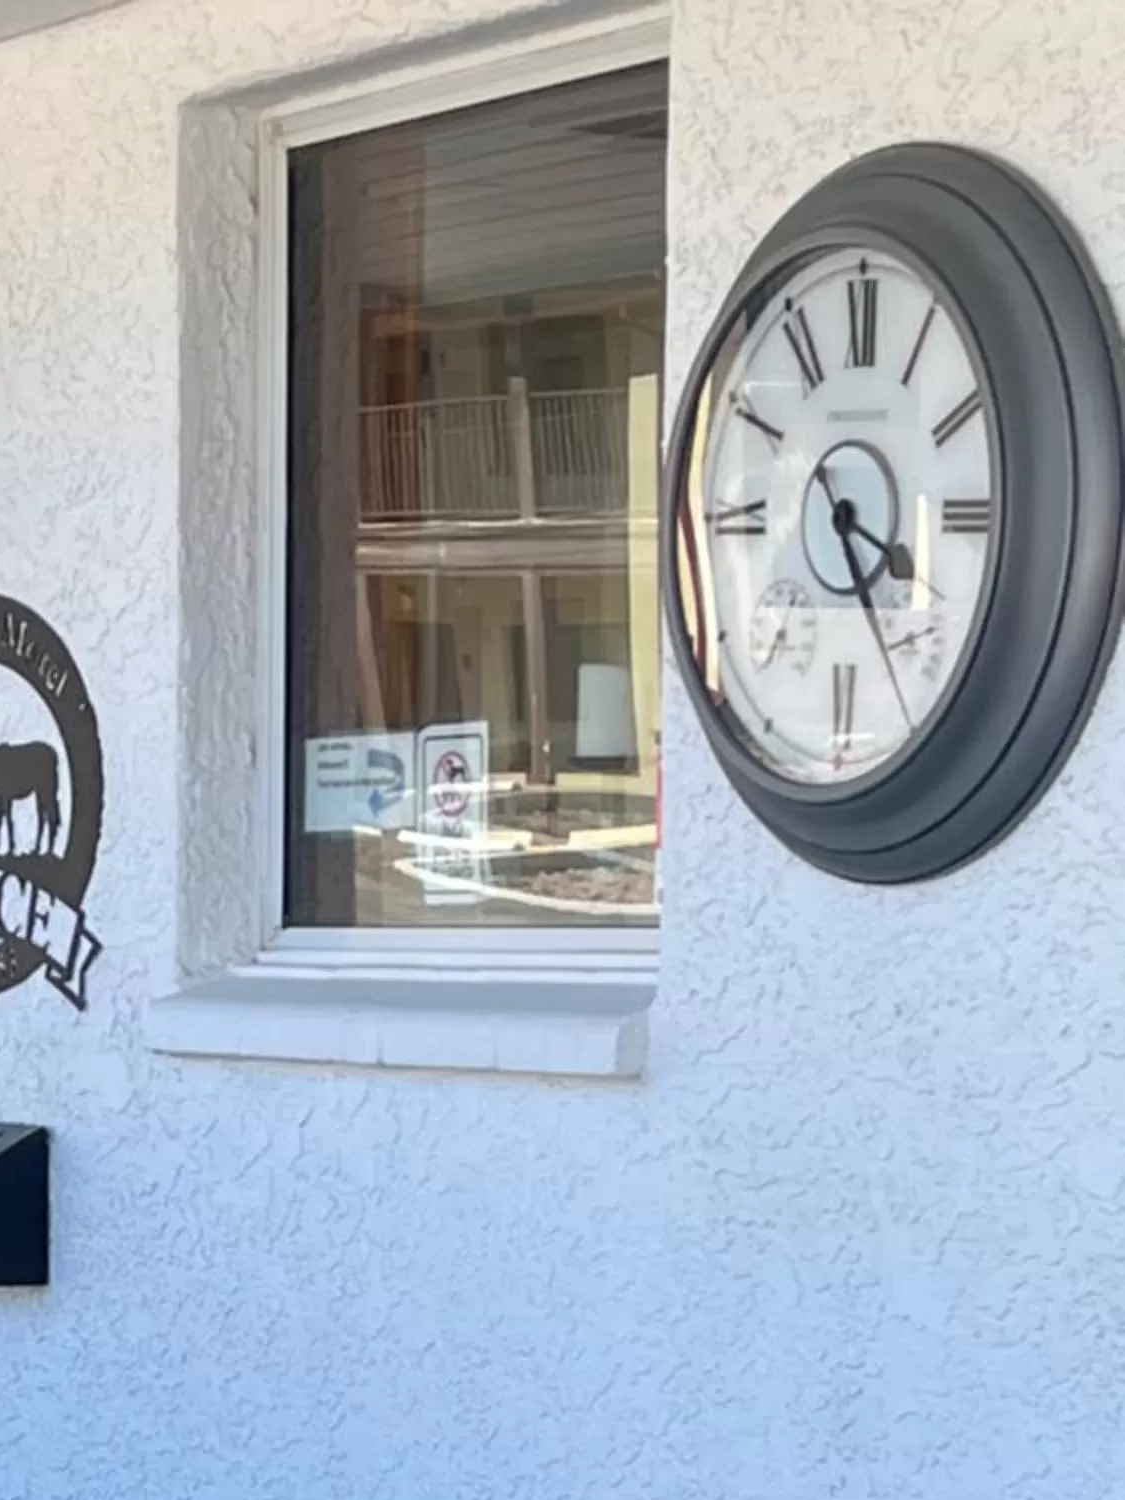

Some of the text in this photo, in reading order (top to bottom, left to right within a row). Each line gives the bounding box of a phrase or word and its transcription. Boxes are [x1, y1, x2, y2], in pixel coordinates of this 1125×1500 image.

[843, 278, 878, 369] XII
[931, 388, 984, 448] II
[942, 499, 989, 533] III
